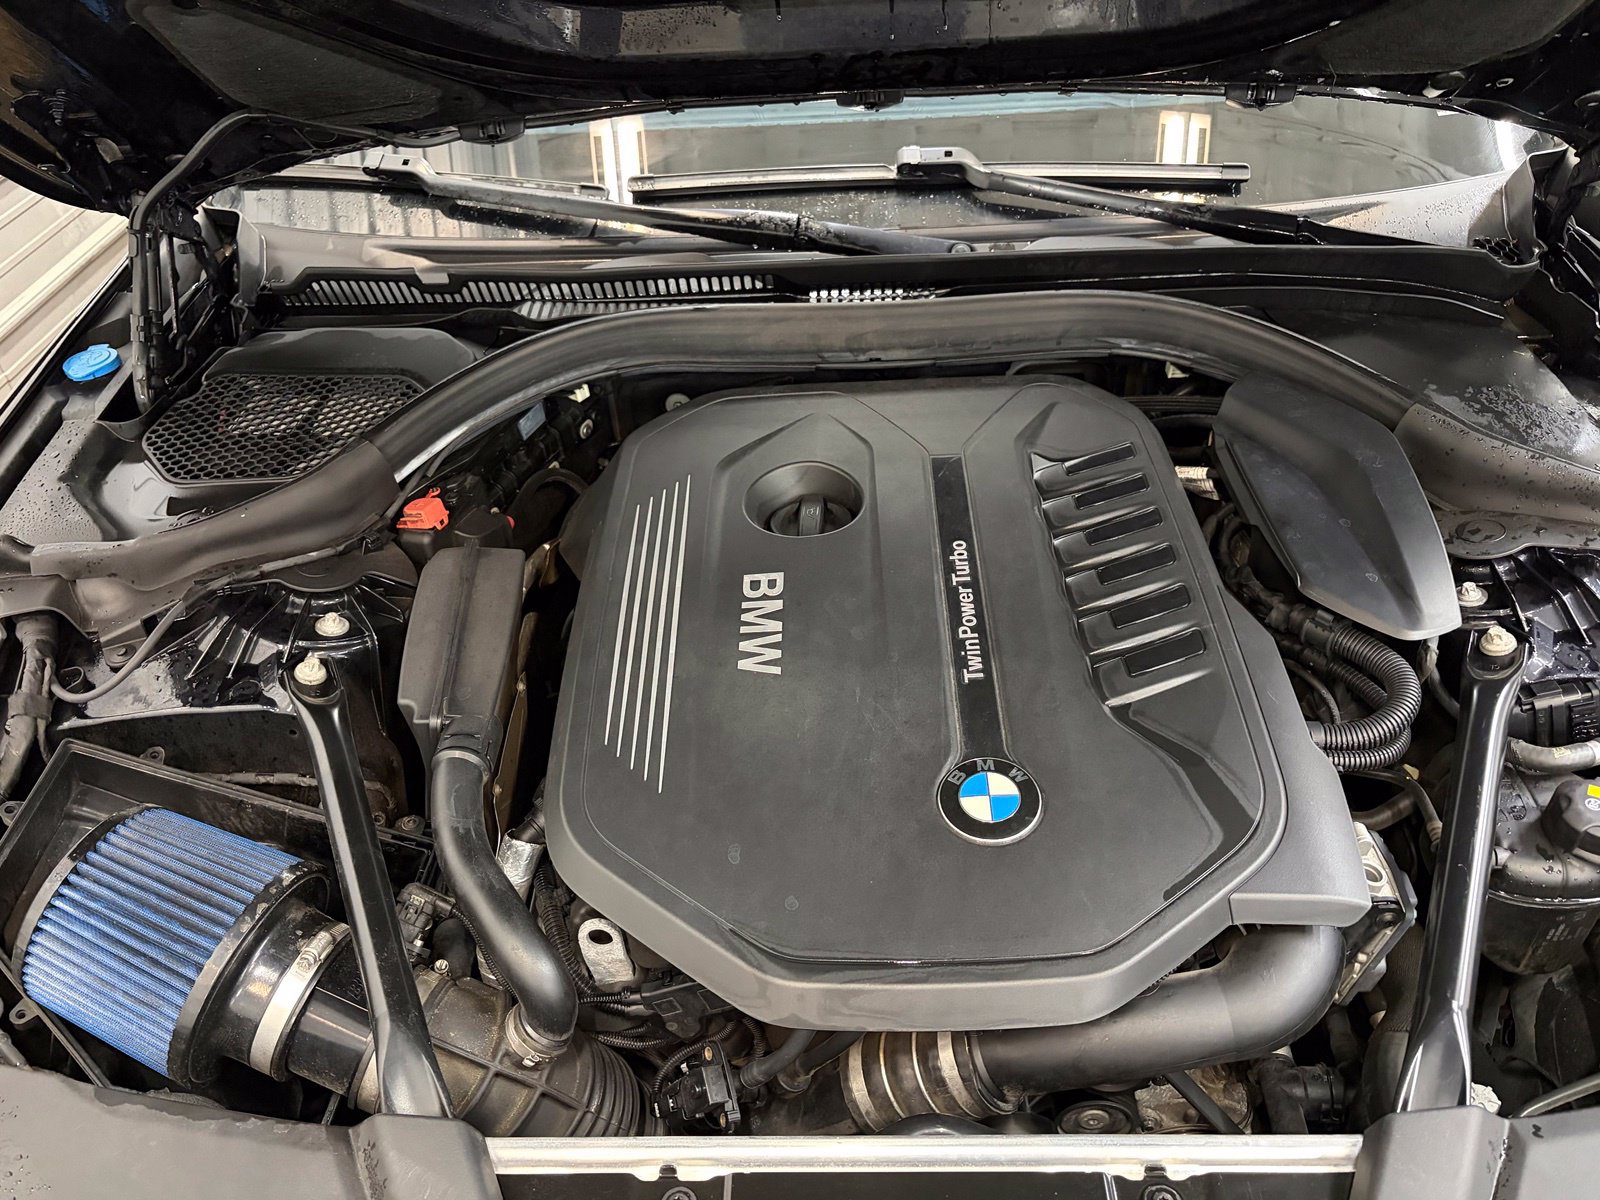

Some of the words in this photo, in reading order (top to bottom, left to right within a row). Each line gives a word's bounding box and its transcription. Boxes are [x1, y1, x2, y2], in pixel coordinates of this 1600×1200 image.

[949, 540, 971, 586] Turbo
[737, 571, 785, 676] BMW
[958, 586, 984, 684] TwinPower
[947, 759, 1029, 786] BMW
